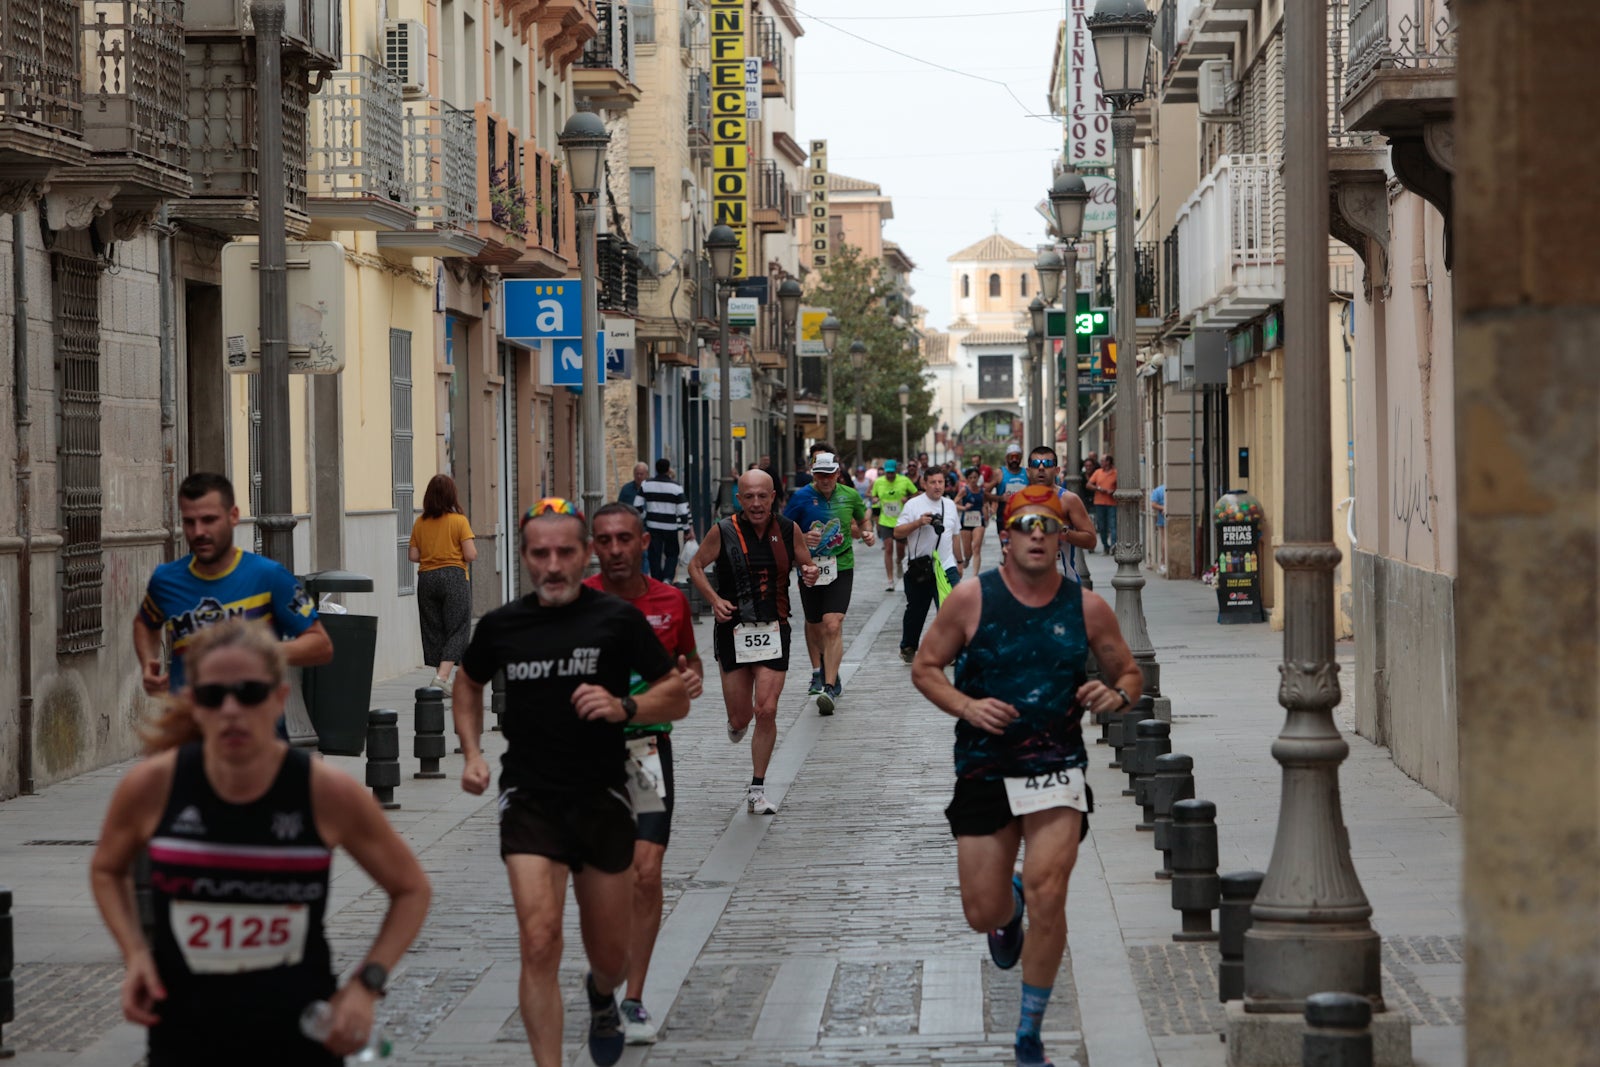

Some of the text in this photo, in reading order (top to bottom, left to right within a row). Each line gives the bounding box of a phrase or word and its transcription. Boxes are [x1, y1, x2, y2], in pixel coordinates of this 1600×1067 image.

[813, 142, 827, 265] PIONONOS
[536, 299, 564, 332] a
[1222, 525, 1252, 533] BEBIDAS
[745, 634, 771, 647] 552
[573, 648, 600, 658] GYM
[507, 658, 598, 680] BODY LINE
[1025, 768, 1070, 790] 426
[187, 914, 291, 949] 2125
